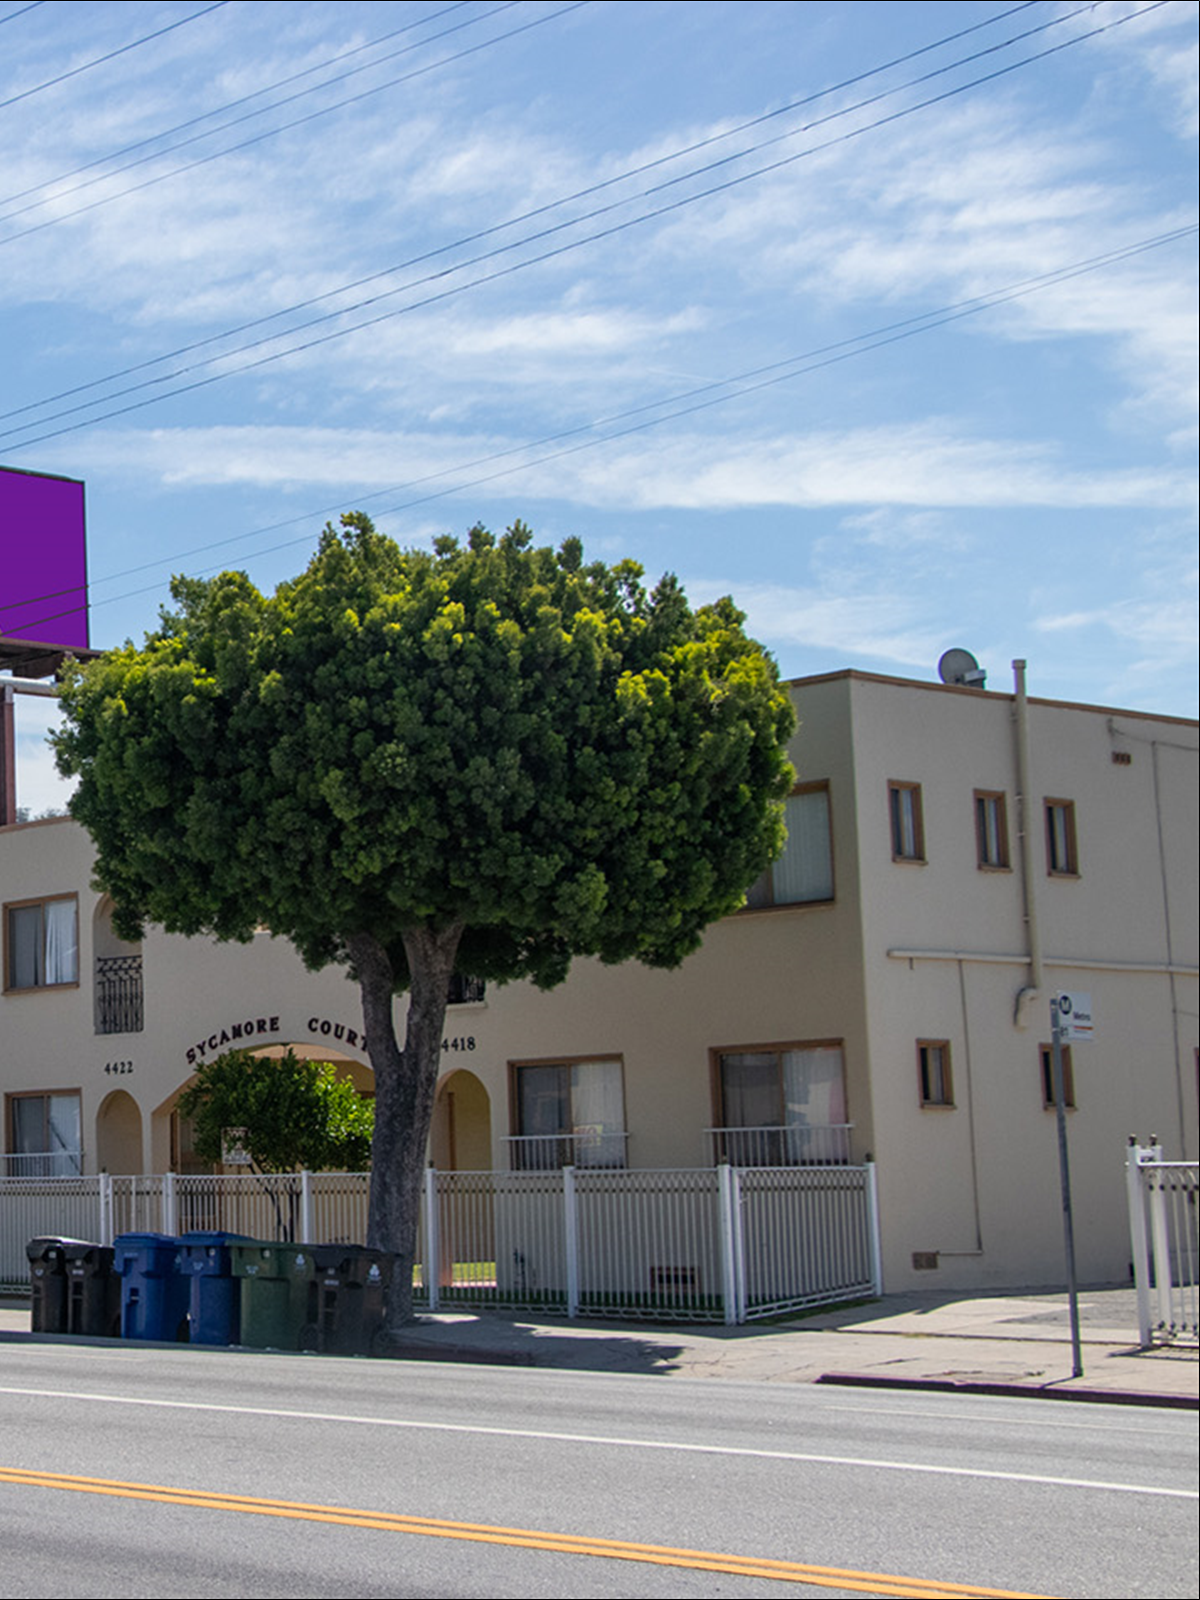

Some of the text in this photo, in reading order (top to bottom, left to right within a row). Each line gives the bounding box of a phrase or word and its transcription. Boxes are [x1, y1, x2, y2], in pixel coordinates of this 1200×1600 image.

[186, 1016, 280, 1064] SYCAMORE
[441, 1037, 476, 1052] 4418
[104, 1061, 134, 1075] 4422
